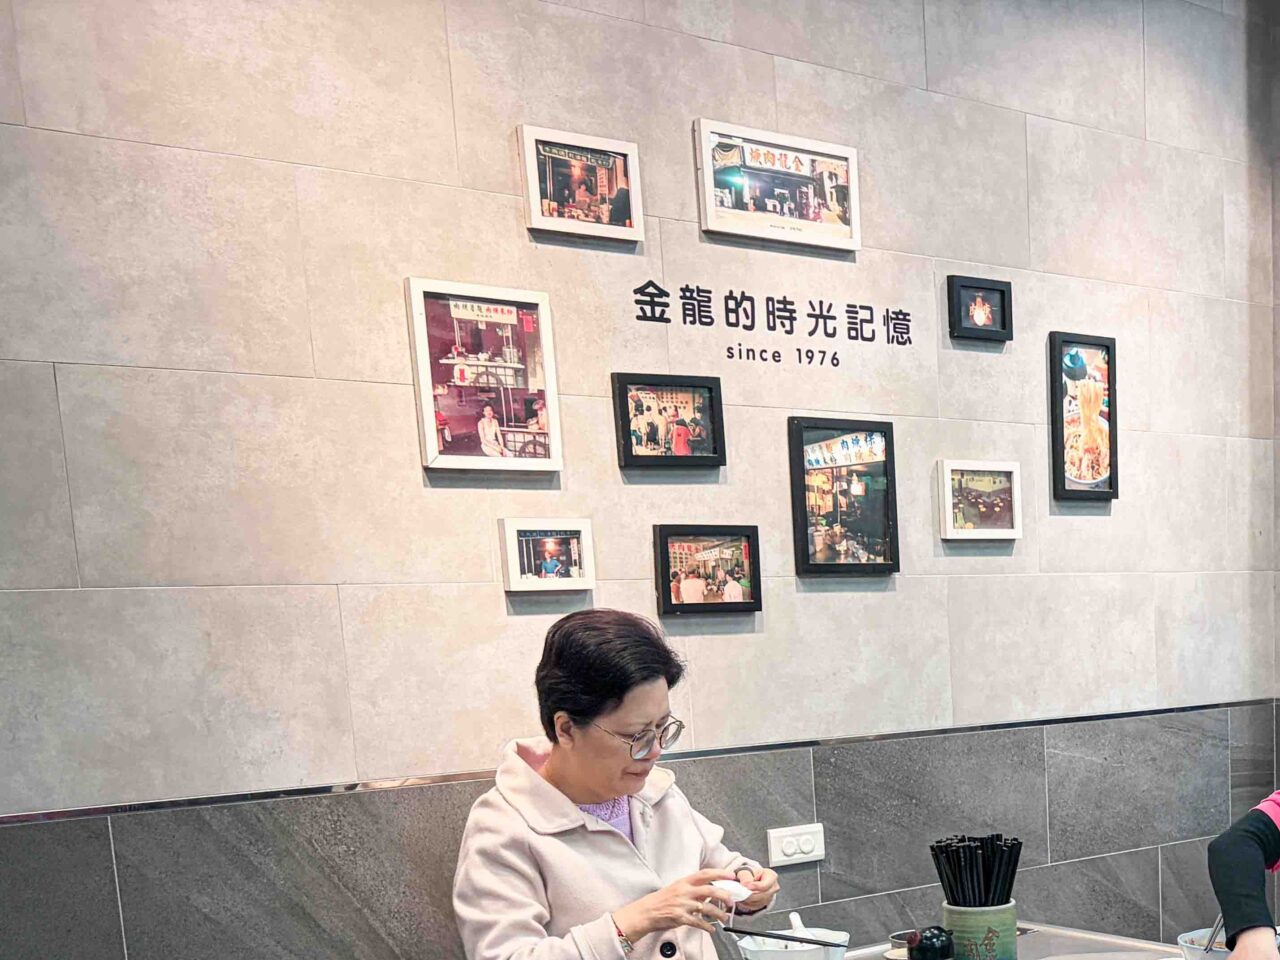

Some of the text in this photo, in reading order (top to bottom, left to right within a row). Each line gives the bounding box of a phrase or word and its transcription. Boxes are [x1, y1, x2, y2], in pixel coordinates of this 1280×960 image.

[633, 280, 912, 346] 金龍的時光記憶
[726, 343, 840, 368] since 1976
